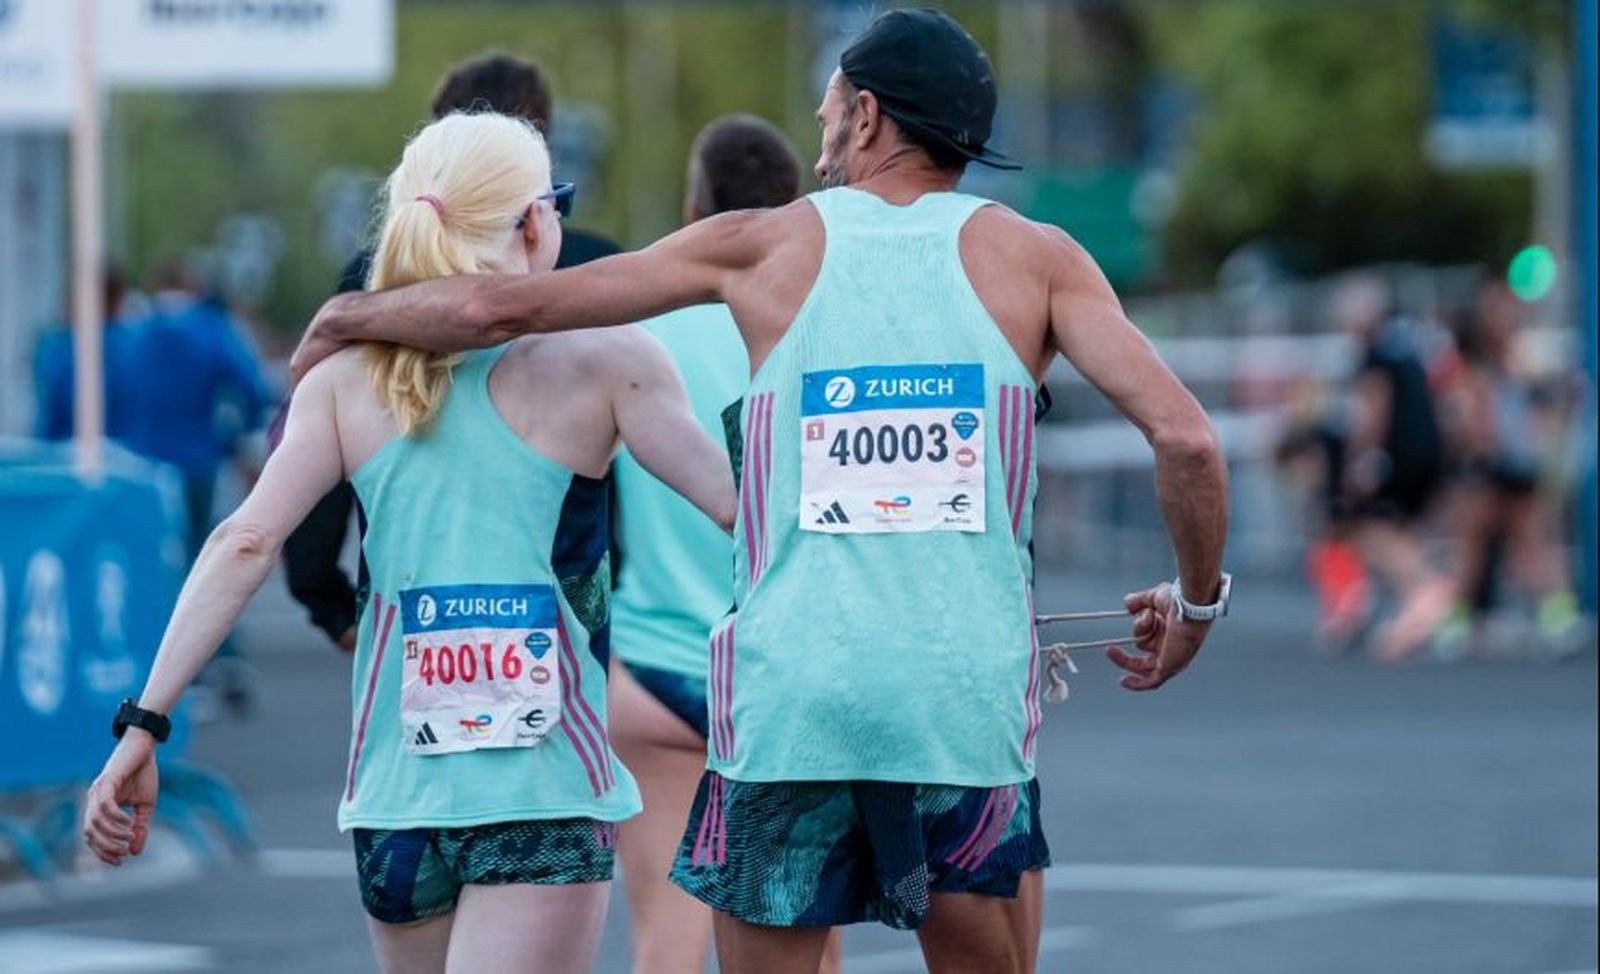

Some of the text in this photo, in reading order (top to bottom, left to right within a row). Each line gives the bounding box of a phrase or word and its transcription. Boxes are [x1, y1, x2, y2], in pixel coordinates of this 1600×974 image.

[865, 379, 954, 398] ZURICH
[828, 422, 949, 467] 40003
[444, 598, 528, 618] ZURICH
[419, 641, 523, 687] 40016
